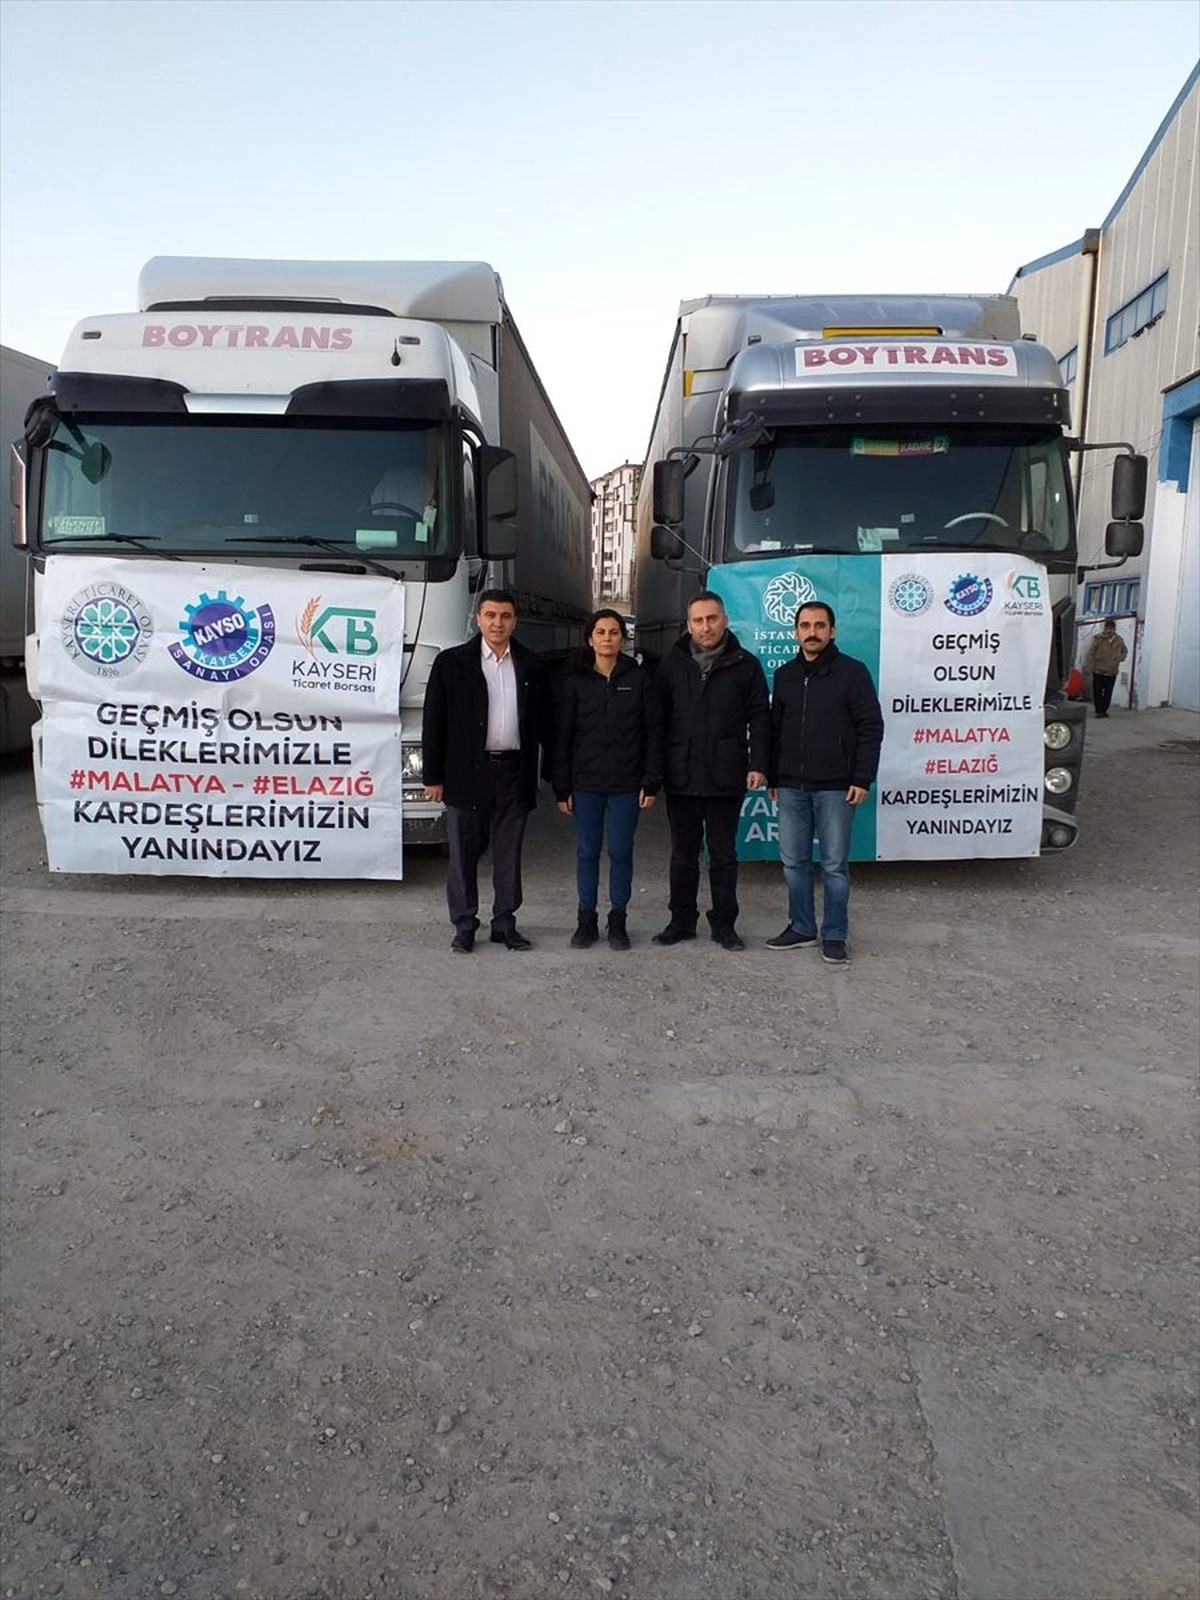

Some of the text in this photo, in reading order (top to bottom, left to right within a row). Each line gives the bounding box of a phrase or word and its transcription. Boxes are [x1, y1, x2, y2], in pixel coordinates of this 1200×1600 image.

[142, 325, 353, 350] BOYTRANS
[804, 346, 1008, 367] BOYTRANS
[193, 613, 245, 646] KAYSO
[249, 611, 274, 667] ODASI
[754, 628, 797, 640] İSTAN
[758, 642, 800, 654] TİCAR
[932, 629, 1001, 654] GEÇMİŞ
[292, 660, 377, 681] KAYSERİ
[767, 659, 787, 669] OD
[934, 665, 996, 681] OLSUN
[292, 679, 376, 693] Ticaret Borsası
[892, 692, 1032, 713] DİLEKLERİMİZLE
[96, 700, 343, 737] GEÇMİŞ OLSUN
[914, 728, 1011, 744] #MALATYA
[88, 731, 352, 766] DİLEKLERİMİZLE
[925, 754, 999, 774] #ELAZIĞ
[69, 769, 225, 794] #MALATYA
[253, 771, 374, 797] #ELAZIĞ
[881, 784, 1038, 809] KARDEŞLERİMİZİN
[73, 799, 370, 833] KARDEŞLERİMİZİN
[744, 822, 779, 843] AR
[907, 819, 1013, 835] YANINDAYIZ
[121, 836, 322, 862] YANINDAYIZ
